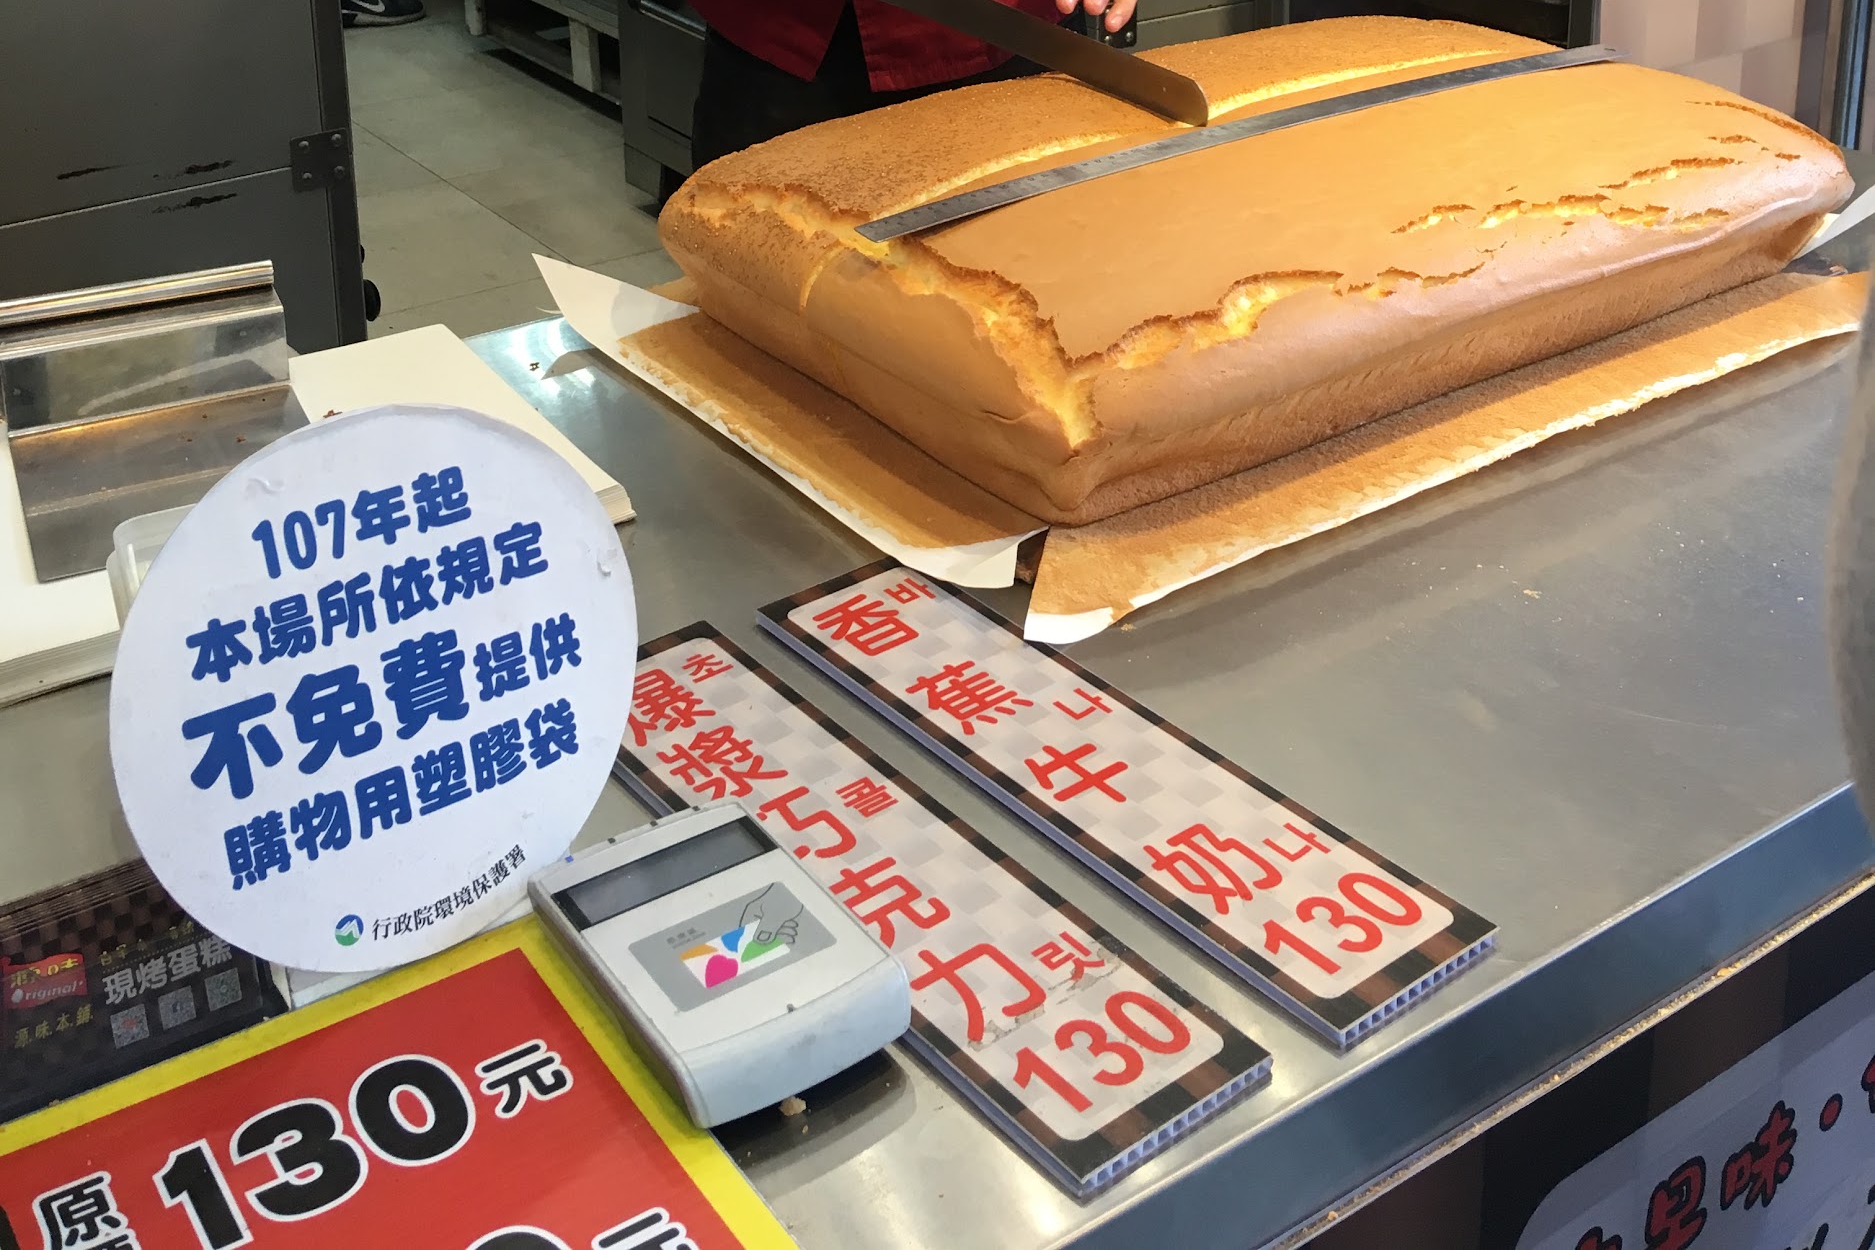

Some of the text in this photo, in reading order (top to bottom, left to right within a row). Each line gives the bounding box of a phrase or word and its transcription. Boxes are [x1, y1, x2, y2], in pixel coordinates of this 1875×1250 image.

[252, 466, 472, 579] 107年起
[186, 522, 549, 682] 本場所依規定
[224, 698, 580, 890] 購物用塑膠袋
[813, 593, 1284, 915] 香蕉牛奶
[372, 844, 526, 941] 行政院環境保護署
[1264, 872, 1423, 975] 130
[1013, 990, 1192, 1114] 130
[34, 1172, 136, 1250] 原
